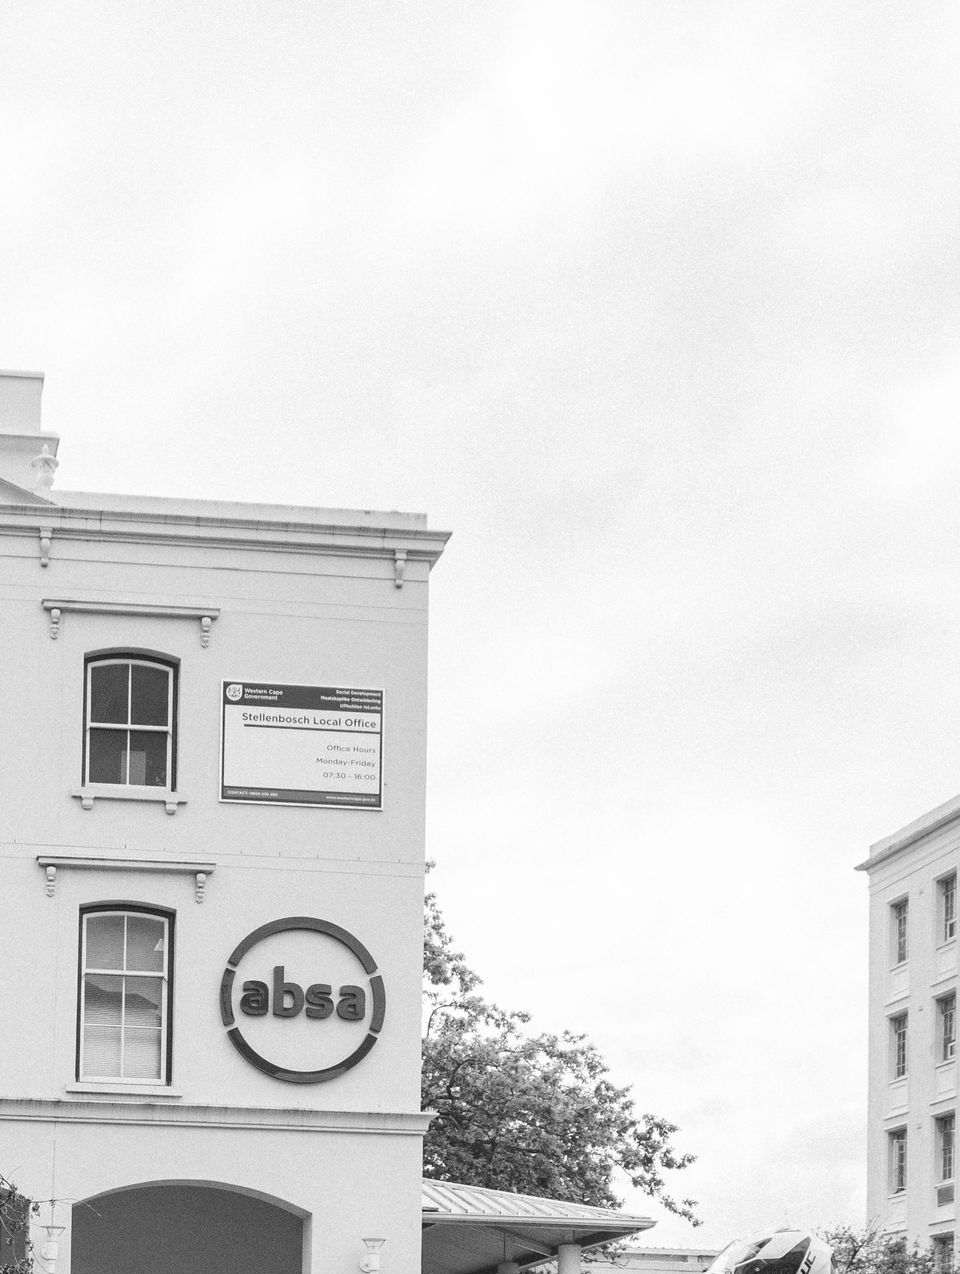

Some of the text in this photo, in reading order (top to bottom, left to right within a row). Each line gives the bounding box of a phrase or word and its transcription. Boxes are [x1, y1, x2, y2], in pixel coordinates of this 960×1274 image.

[244, 693, 278, 701] Government
[242, 712, 376, 728] Stellenbosch Local Office
[326, 744, 376, 754] Office Hours
[316, 757, 376, 767] Monday-Friday
[354, 773, 376, 781] 16:00
[239, 965, 366, 1021] absa
